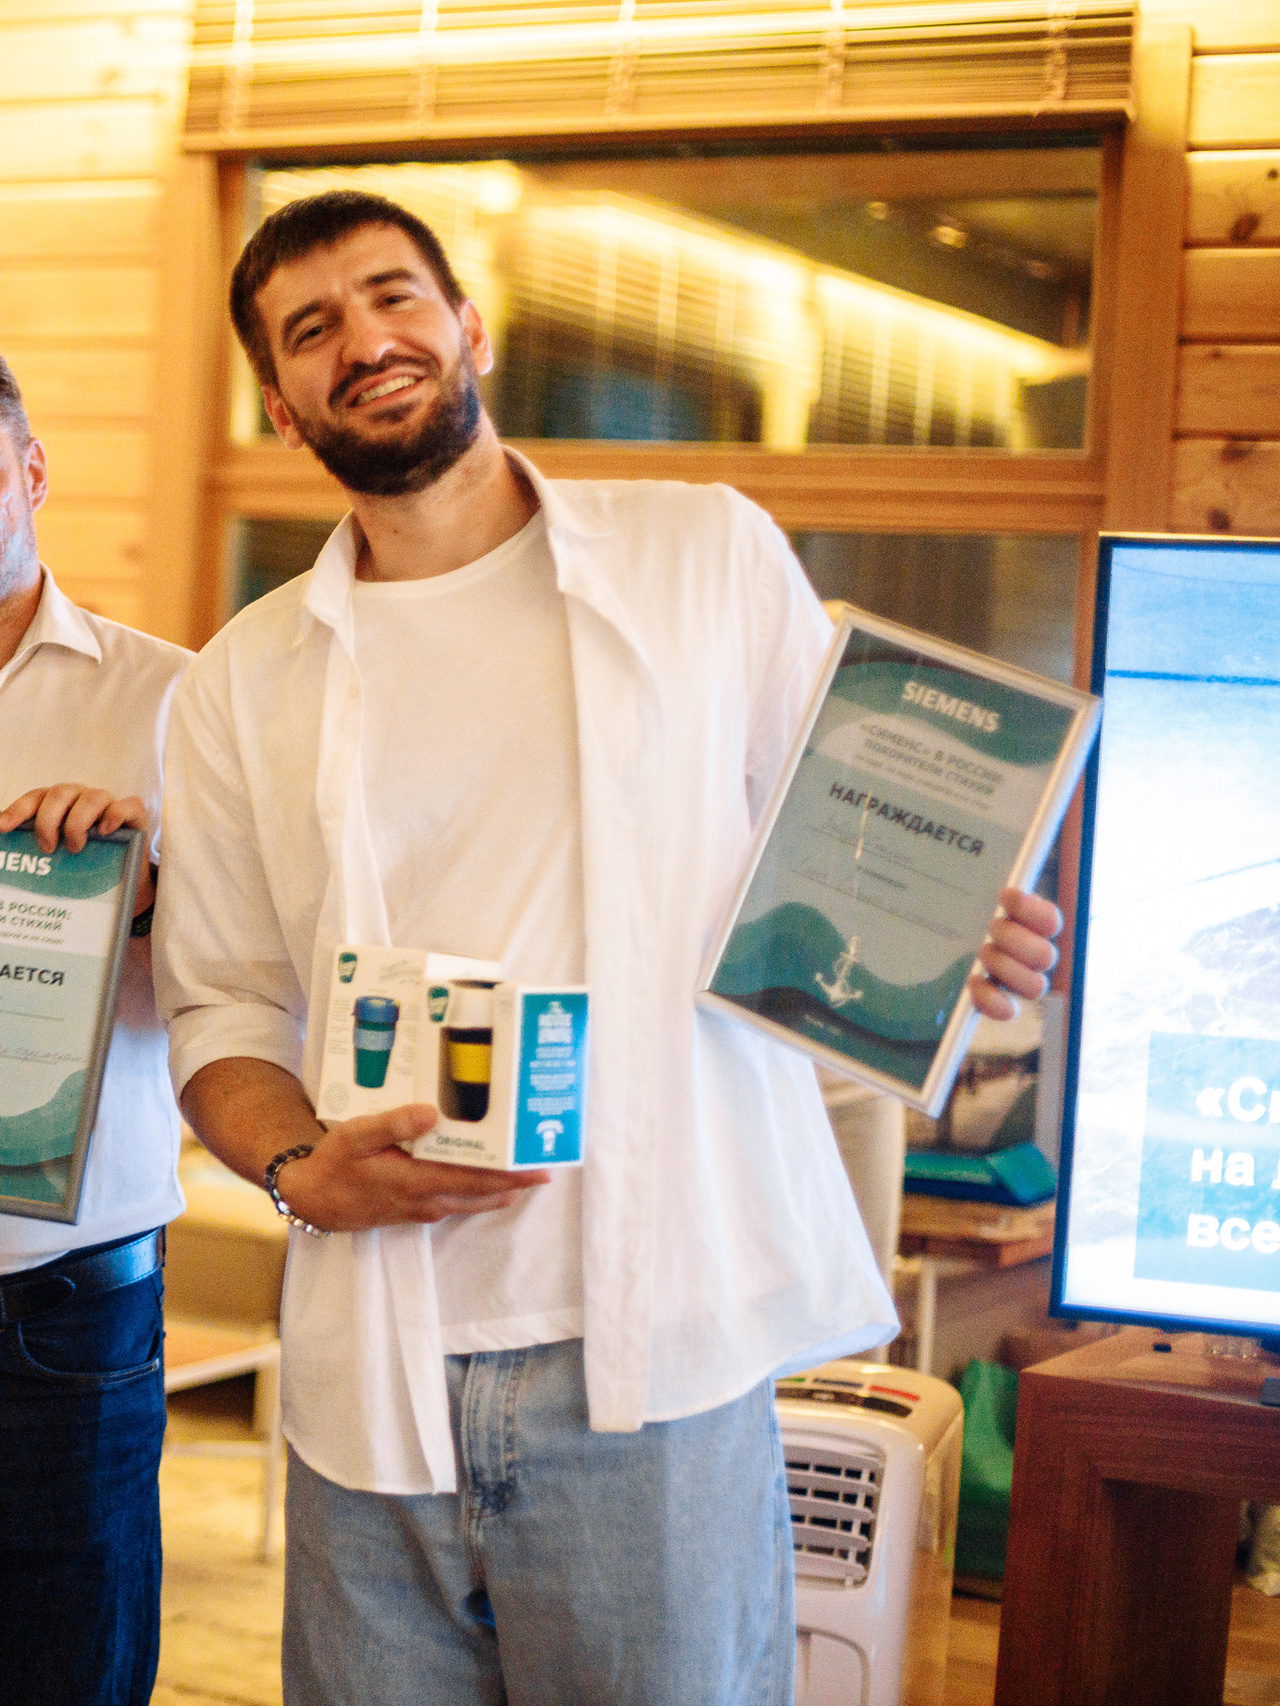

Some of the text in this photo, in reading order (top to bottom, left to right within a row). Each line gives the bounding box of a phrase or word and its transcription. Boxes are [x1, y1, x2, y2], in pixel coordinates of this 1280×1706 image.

[902, 681, 1000, 732] SIEMENS
[829, 782, 985, 857] НАГРАЖДАЕТСЯ
[8, 900, 72, 921] РОССИИ:
[11, 913, 63, 931] СТИХИЙ
[1195, 1076, 1280, 1124] «С
[1190, 1148, 1255, 1187] на
[1186, 1213, 1280, 1254] все
